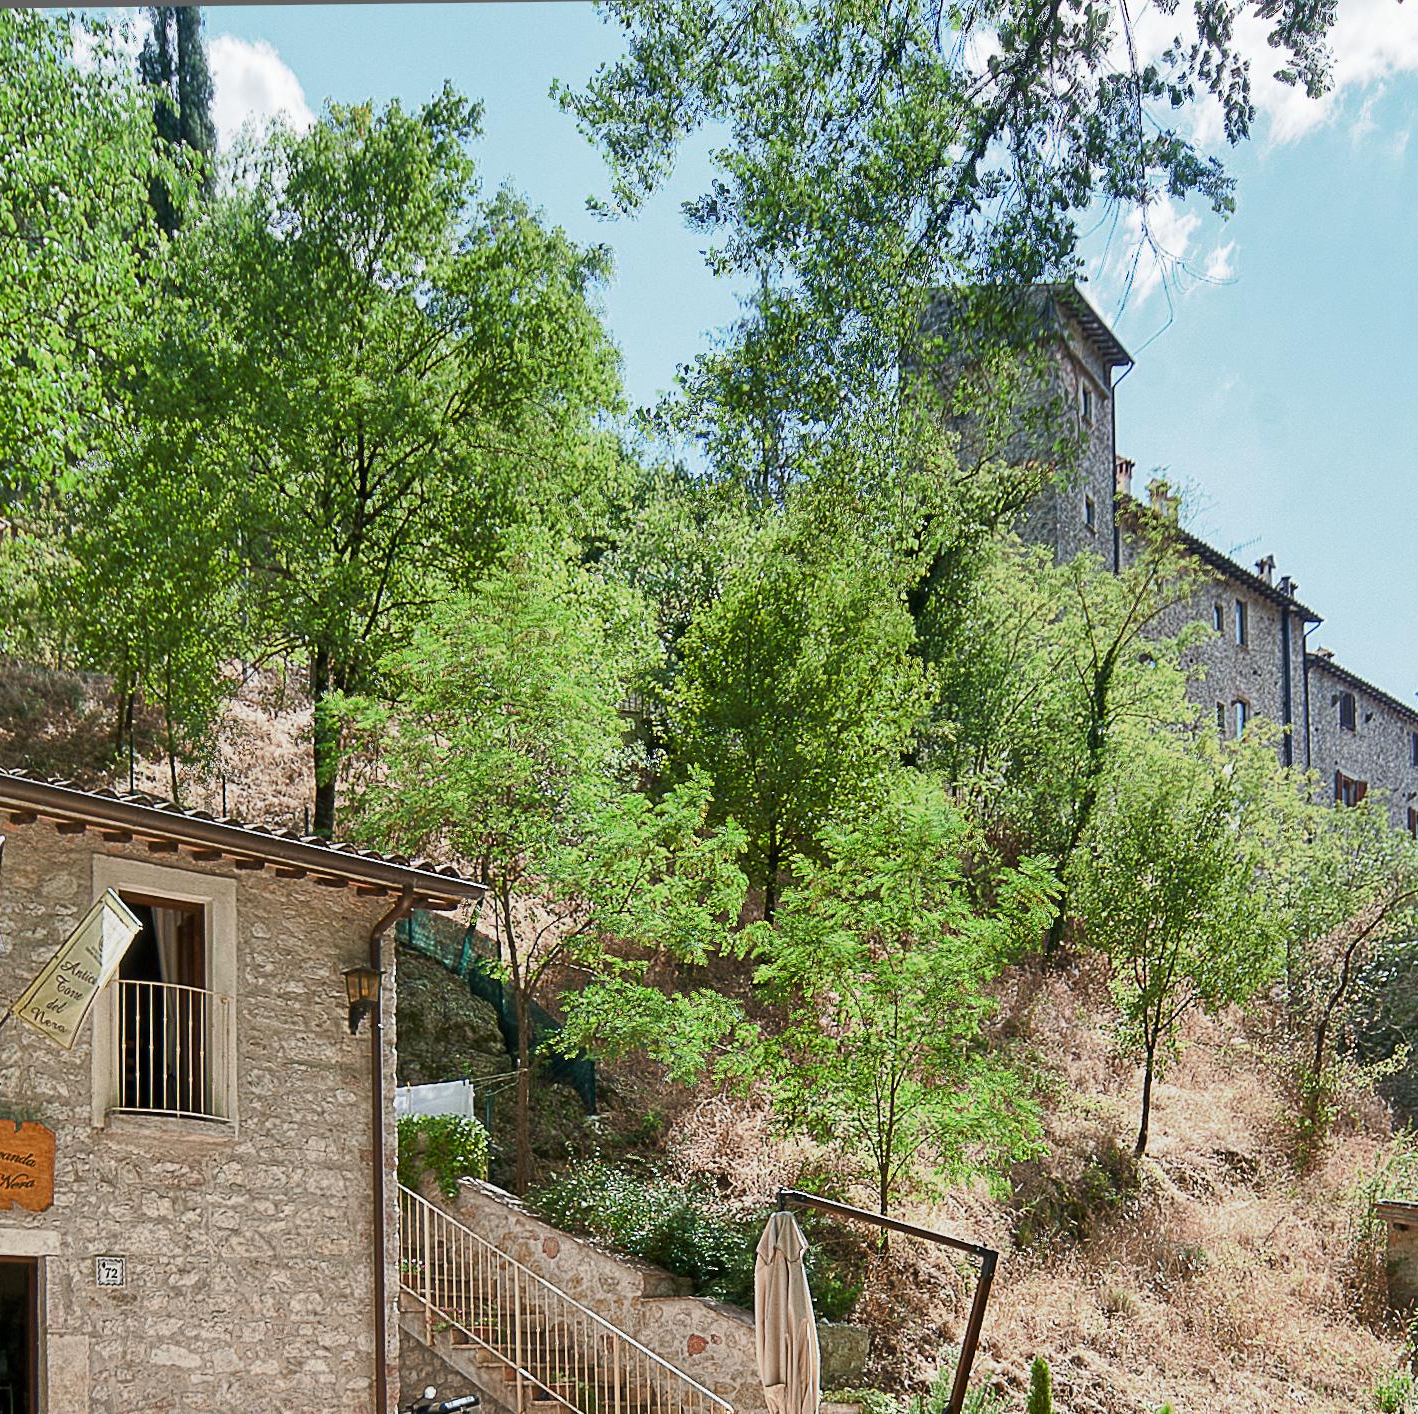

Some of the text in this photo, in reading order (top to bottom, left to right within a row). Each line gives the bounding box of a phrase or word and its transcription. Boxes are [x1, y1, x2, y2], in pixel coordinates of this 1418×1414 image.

[46, 998, 66, 1014] del
[31, 1007, 68, 1033] Nera
[104, 1267, 118, 1279] 72
